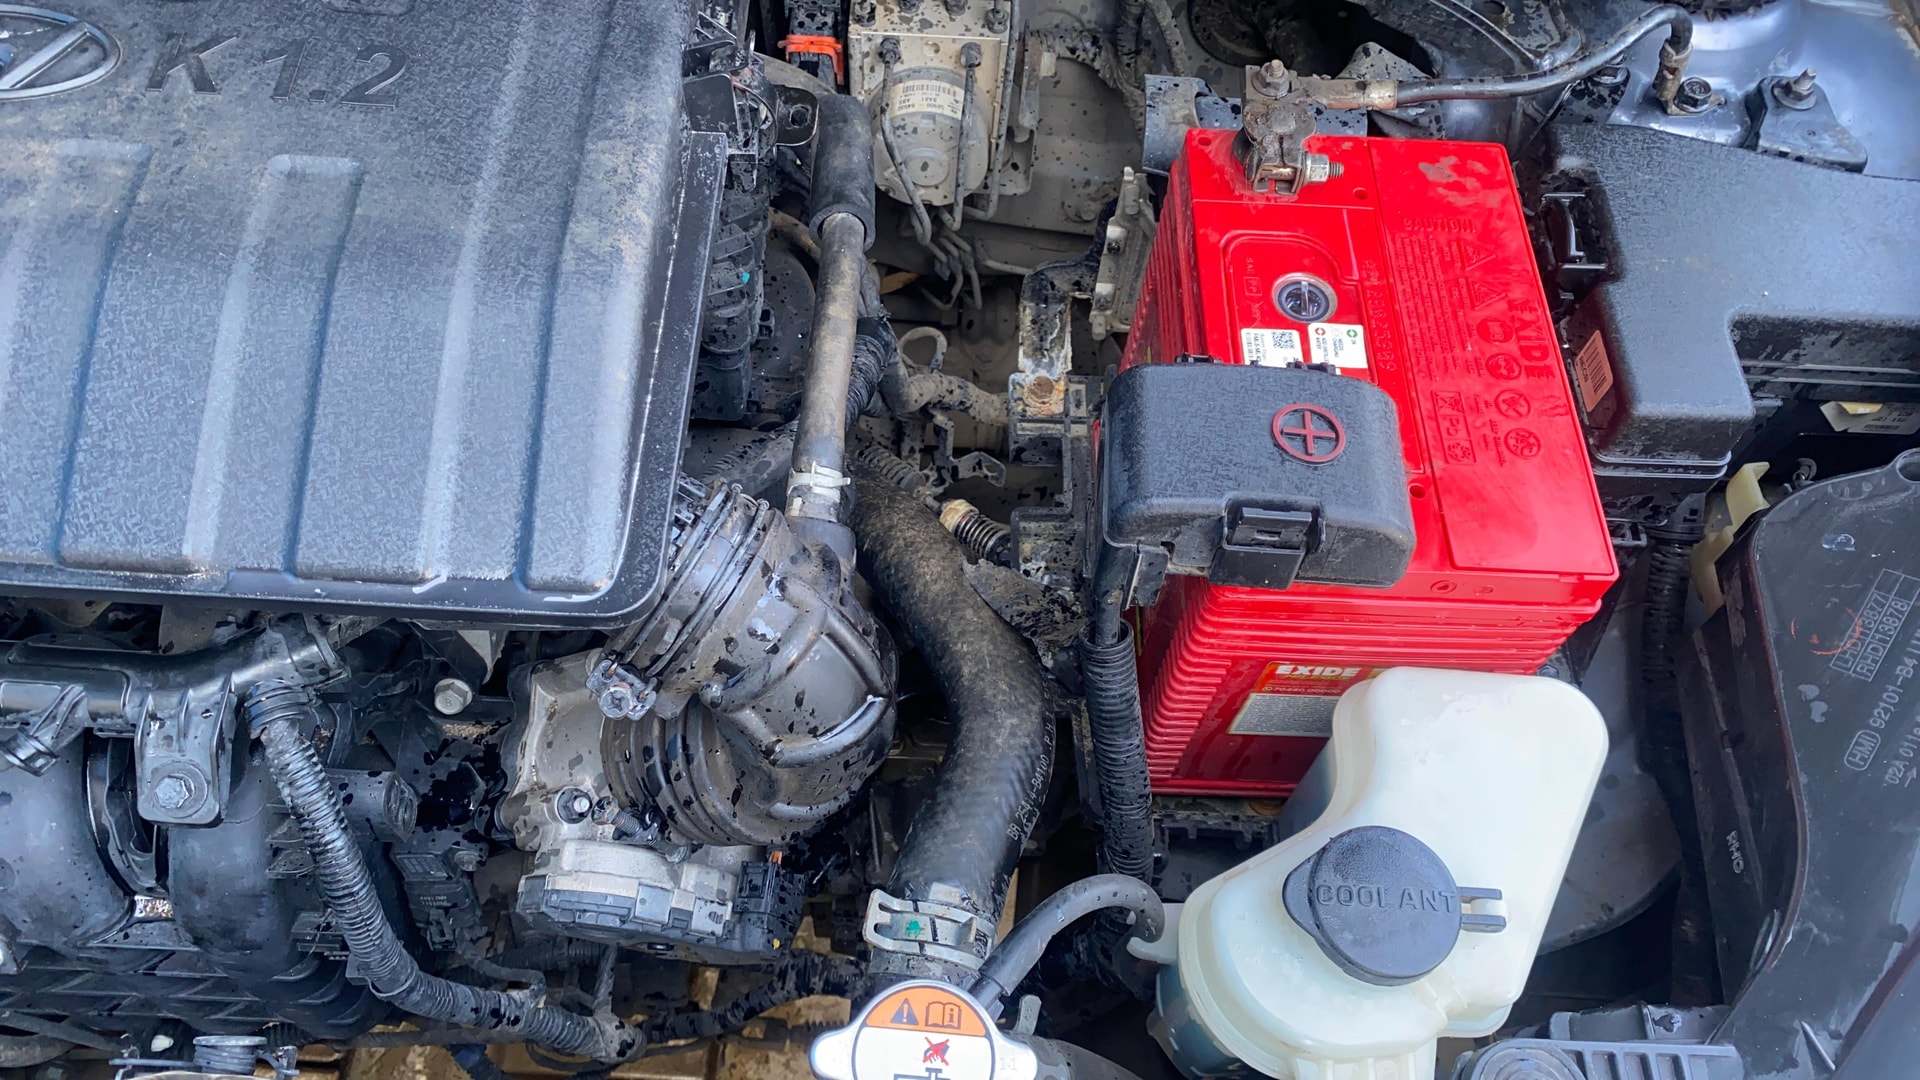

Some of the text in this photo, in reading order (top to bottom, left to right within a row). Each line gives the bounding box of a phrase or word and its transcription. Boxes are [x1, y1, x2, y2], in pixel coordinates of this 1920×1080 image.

[145, 32, 409, 111] K 1.2
[1508, 300, 1556, 381] EXIDE
[1856, 600, 1909, 676] RHD 13878
[1275, 664, 1362, 677] EXIDE
[1848, 734, 1878, 766] HMI
[1884, 760, 1909, 785] 02A
[1315, 884, 1458, 914] COOLANT
